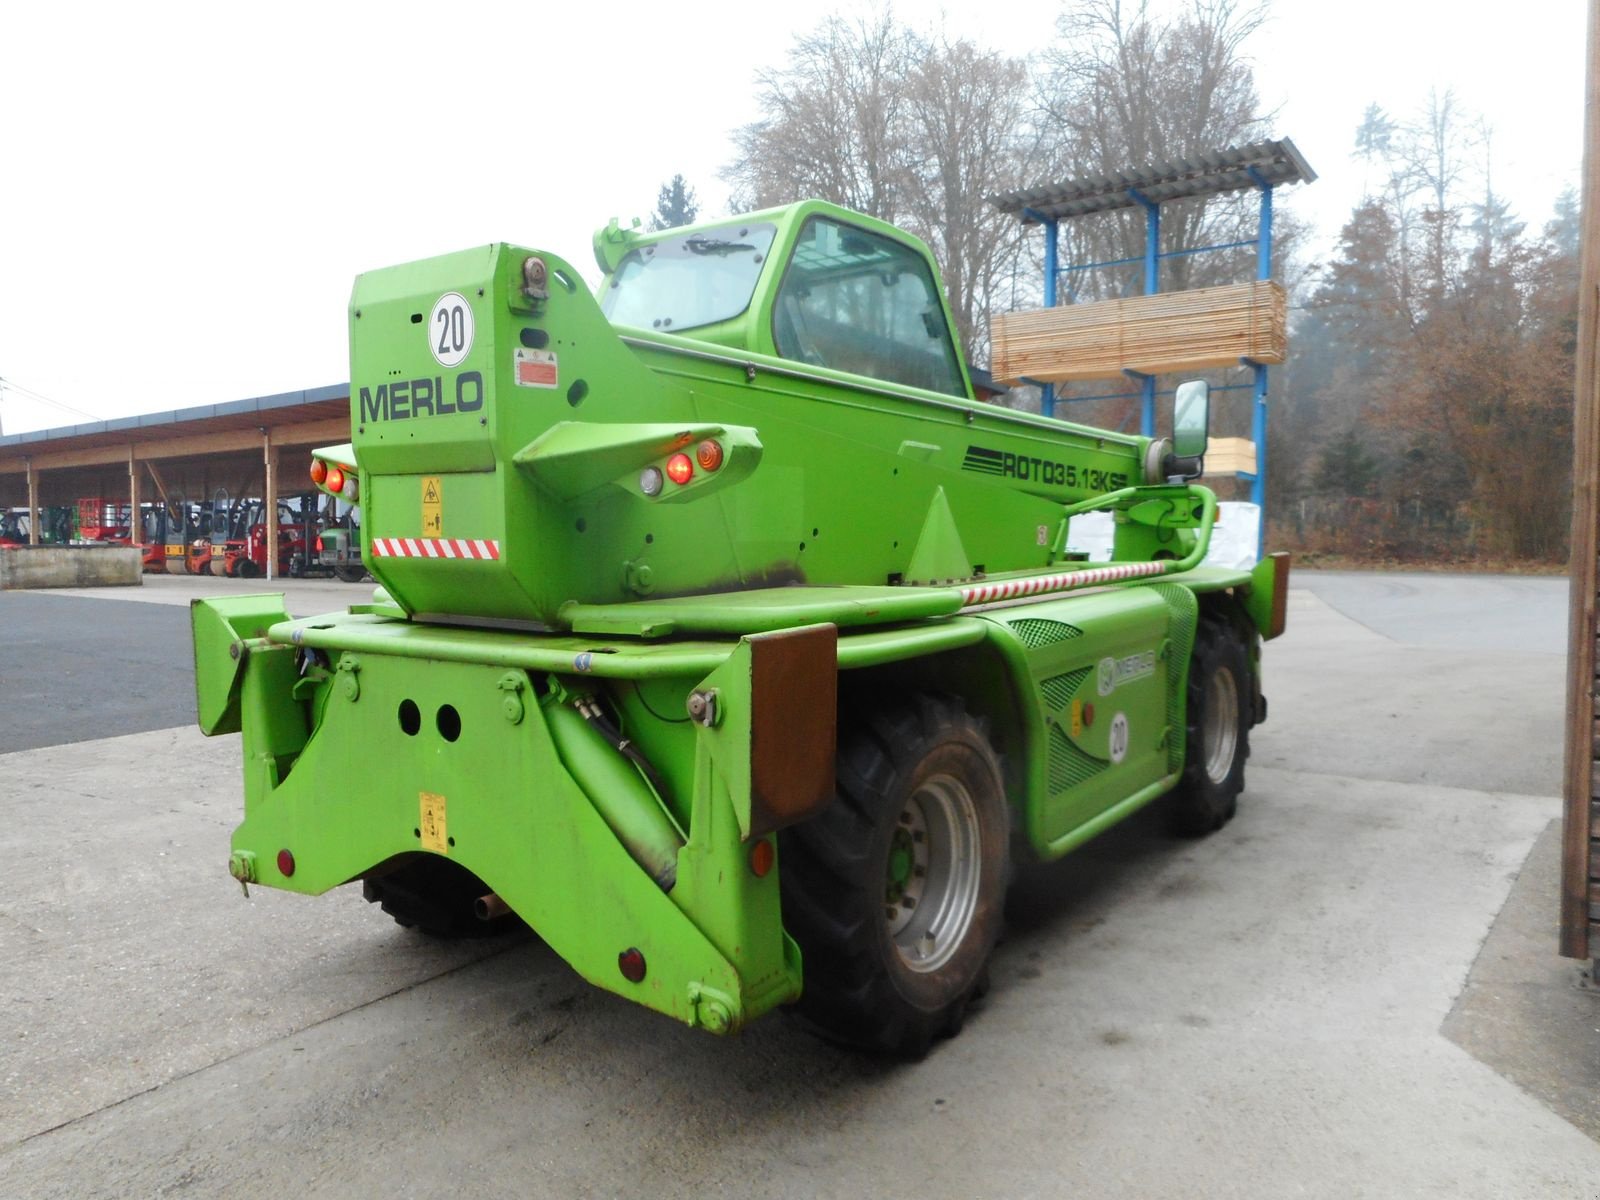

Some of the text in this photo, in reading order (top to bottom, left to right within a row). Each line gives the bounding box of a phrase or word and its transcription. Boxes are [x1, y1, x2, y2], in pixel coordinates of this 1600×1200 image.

[437, 305, 465, 354] 20
[360, 371, 483, 424] MERLO
[1112, 719, 1126, 755] 20
